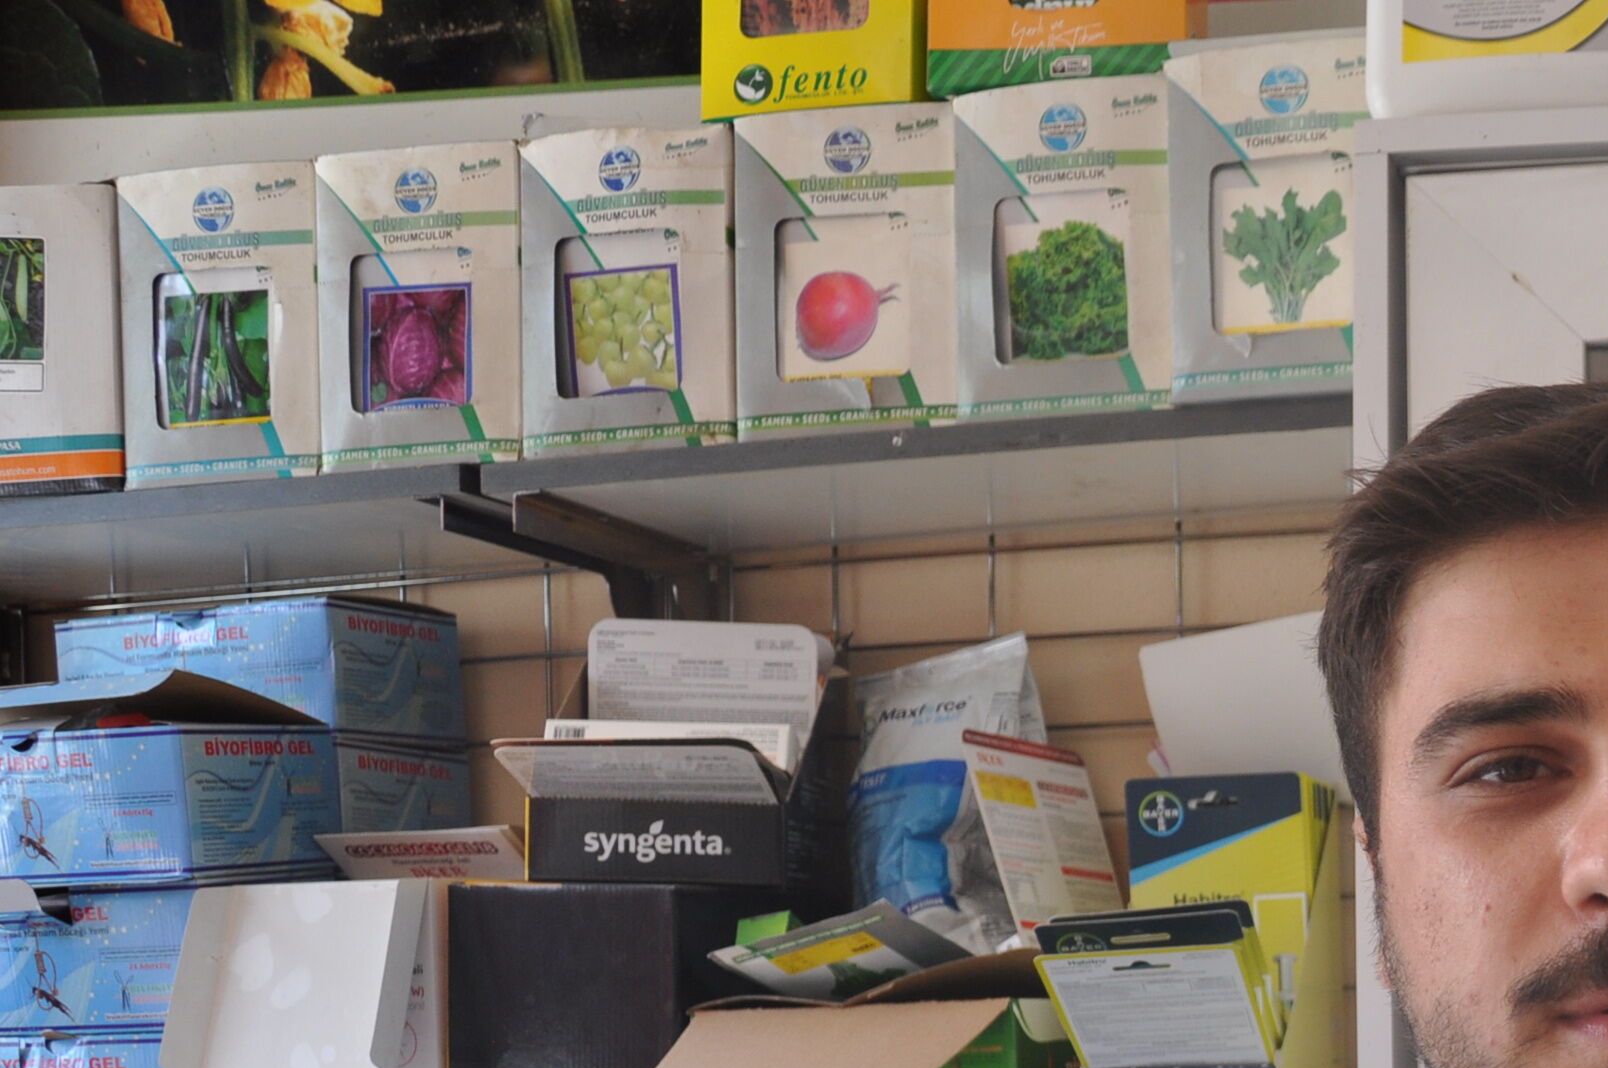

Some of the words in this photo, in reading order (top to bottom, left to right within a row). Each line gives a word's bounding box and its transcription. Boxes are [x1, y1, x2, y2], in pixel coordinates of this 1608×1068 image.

[773, 64, 868, 103] fento
[1246, 131, 1328, 148] TOHUMCULUK
[1027, 169, 1106, 185] TOHUMCULUK
[810, 191, 888, 205] TOHUMCULUK
[586, 208, 658, 225] TOHUMCULUK
[382, 230, 453, 245] TOHUMCULUK
[181, 249, 251, 262] TOHUMCULUK
[761, 415, 793, 427] SAMEN
[890, 407, 928, 419] SEMENT
[542, 434, 572, 446] SAMEN
[663, 425, 699, 436] SEMENT
[340, 451, 370, 461] SAMEN
[456, 442, 490, 453] SEMENT
[143, 465, 173, 477] SAMEN
[256, 456, 289, 467] SEMENT
[216, 626, 249, 642] GEL
[347, 615, 415, 638] BİYOFİBRO
[419, 627, 441, 642] GEL
[204, 736, 283, 757] BİYOFİBRO
[288, 740, 316, 756] GEL
[57, 752, 93, 769] GEL
[358, 754, 425, 776] BİYOFİBRO
[429, 765, 453, 780] GEL
[1142, 808, 1179, 819] BAYER
[583, 829, 724, 862] syngenta
[71, 906, 109, 922] GEL
